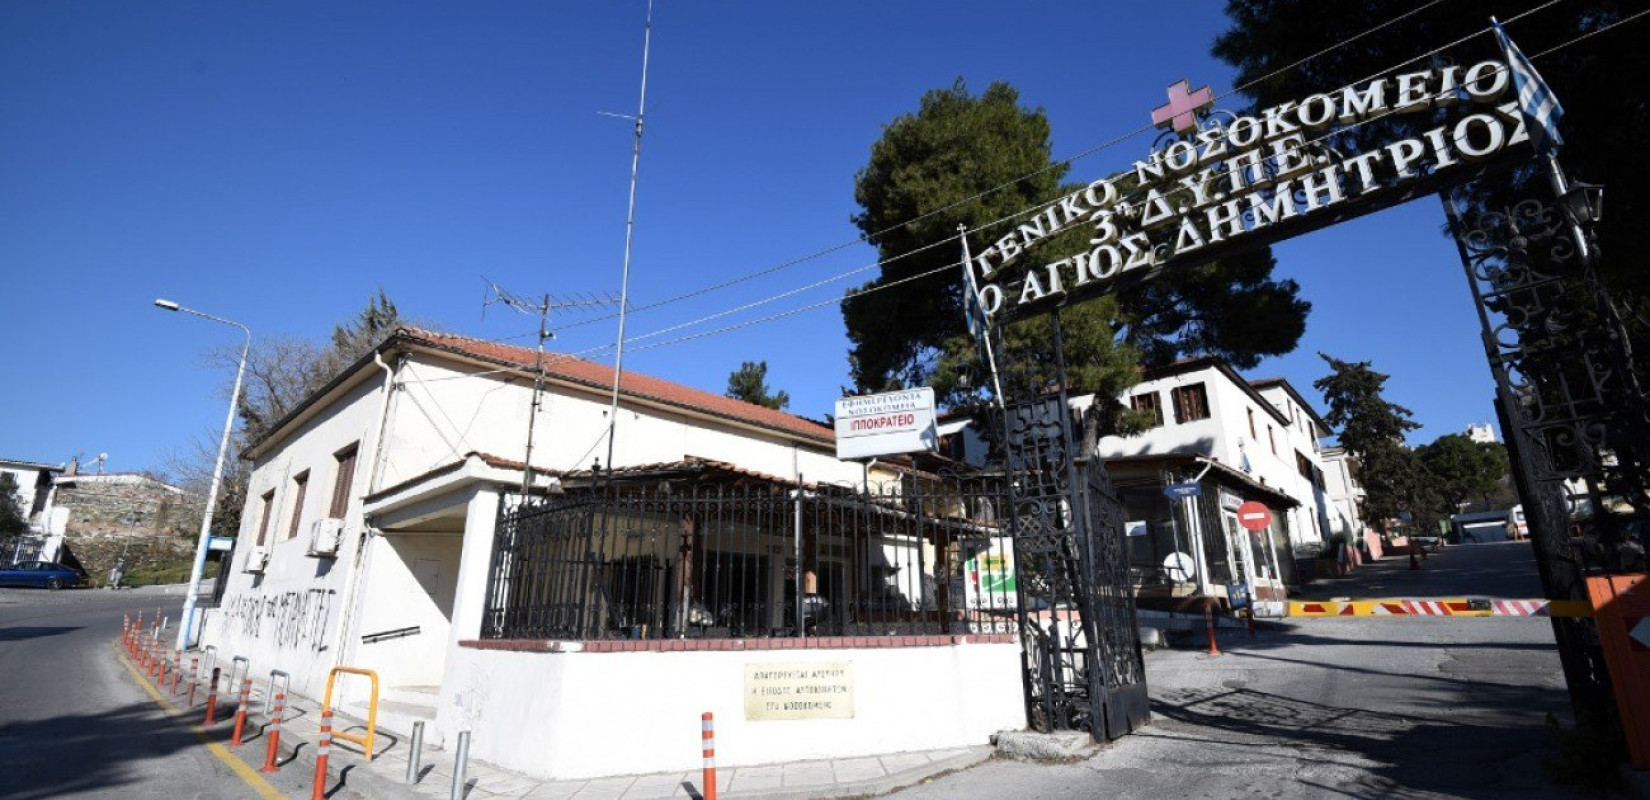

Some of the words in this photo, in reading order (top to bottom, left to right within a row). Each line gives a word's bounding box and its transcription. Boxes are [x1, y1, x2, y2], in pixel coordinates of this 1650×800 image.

[975, 179, 1117, 278] ΓΕΝΙΚΟ
[1132, 60, 1510, 187] ΝΟΣΟΚΟΜΕΙΟ
[979, 283, 1002, 315] Ο
[1018, 231, 1150, 304] ΑΓΙΟΣ
[1173, 100, 1530, 254] ΔΗΜΗΤΡΙΟΣ
[842, 393, 921, 408] ΕΦΗΜΕΡΕΥΟΝΤΑ
[848, 402, 916, 415] ΝΟΣΟΚΟΜΕΙΑ
[850, 413, 915, 431] ΙΠΠΟΚΡΑΤΕΙΟ
